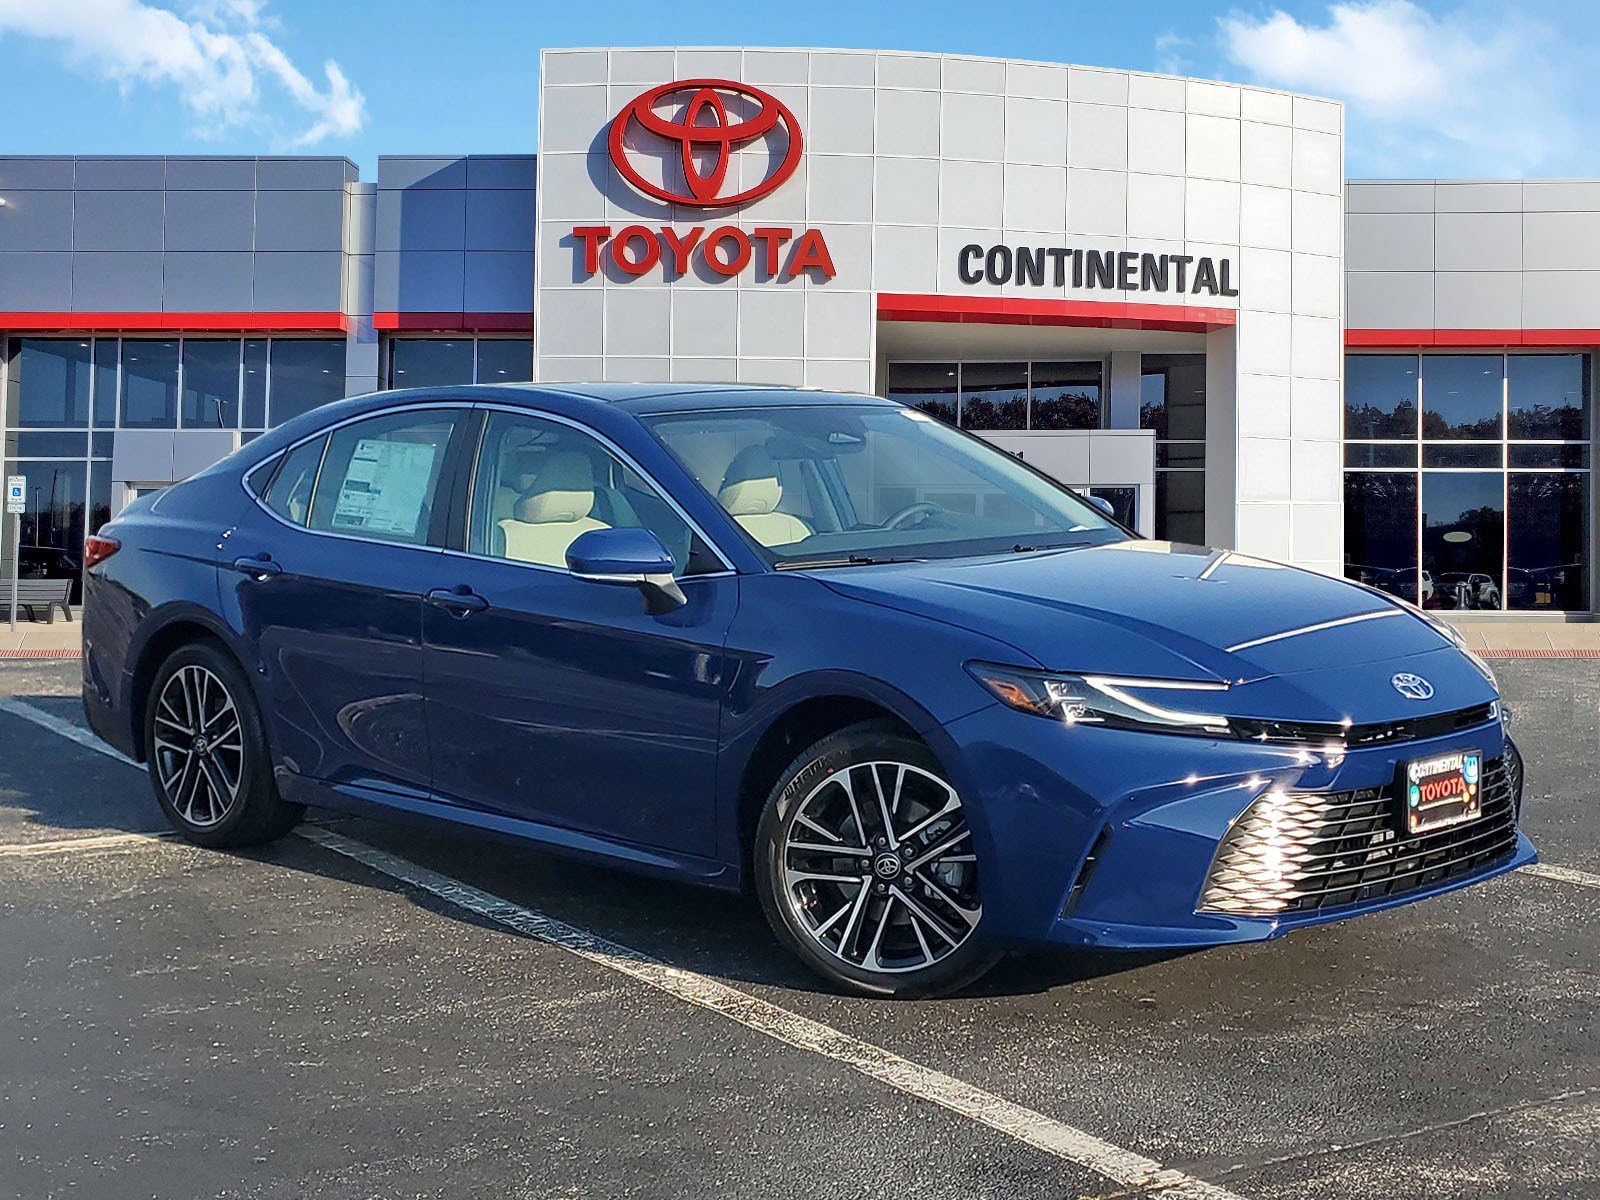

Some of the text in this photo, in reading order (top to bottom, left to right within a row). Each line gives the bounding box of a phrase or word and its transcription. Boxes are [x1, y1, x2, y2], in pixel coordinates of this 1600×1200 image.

[573, 226, 836, 278] TOYOTA
[958, 243, 1239, 297] CONTINENTAL
[1420, 777, 1467, 802] TOYOTA
